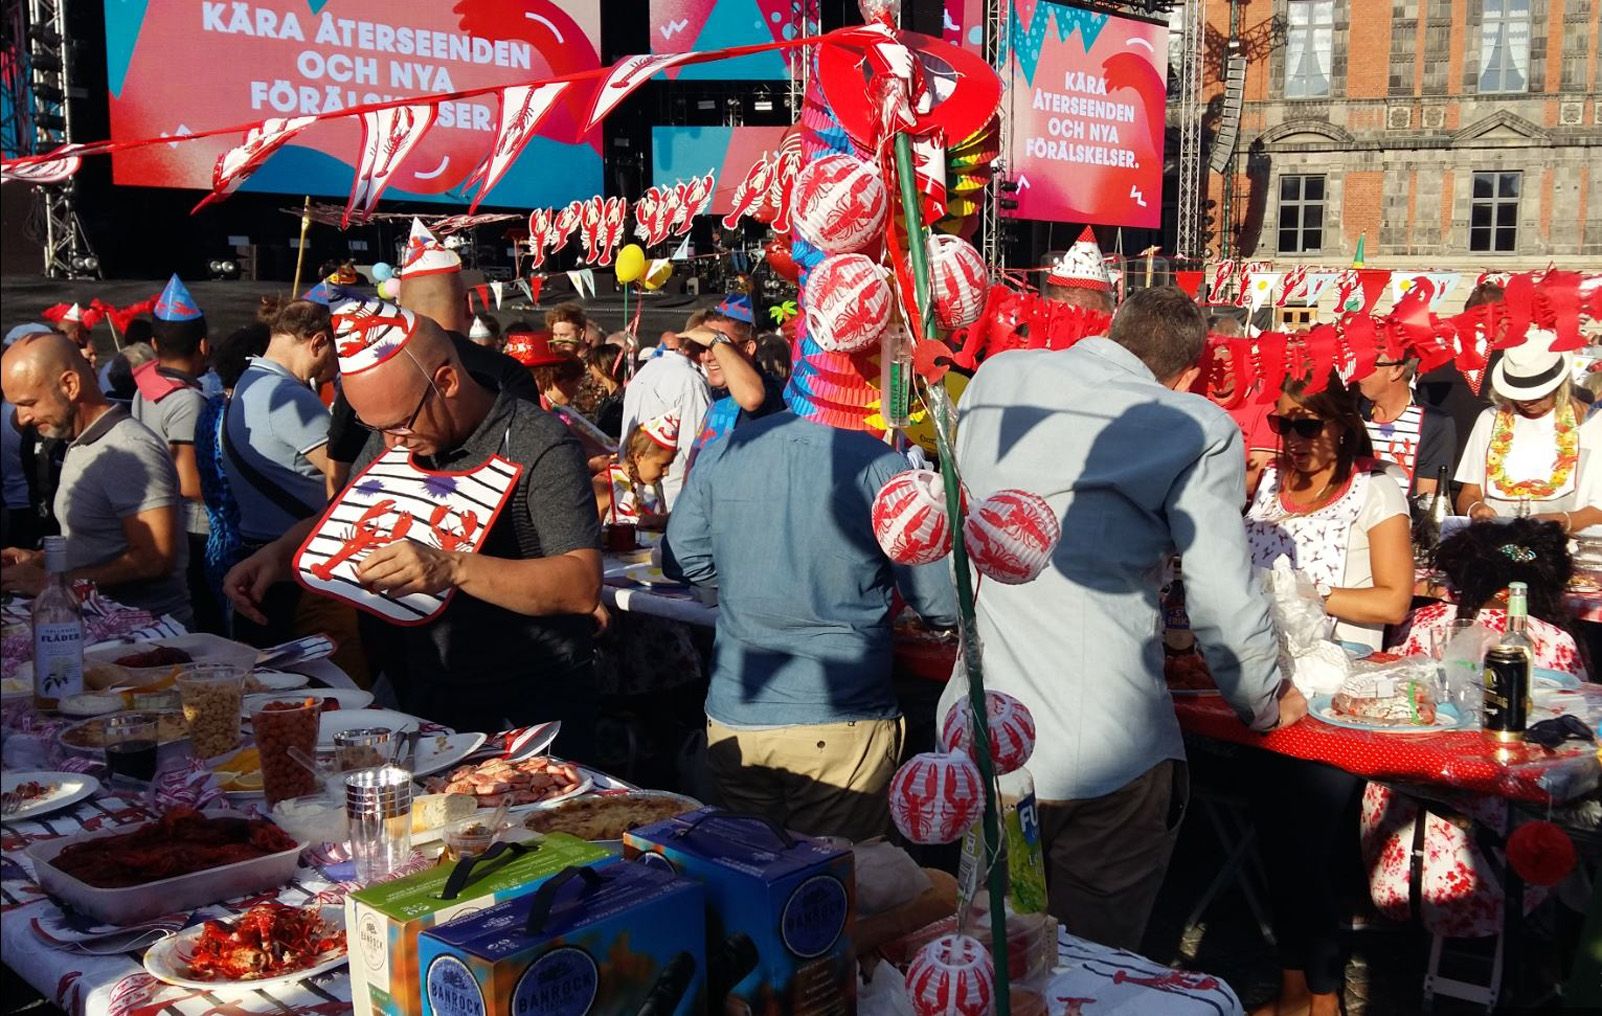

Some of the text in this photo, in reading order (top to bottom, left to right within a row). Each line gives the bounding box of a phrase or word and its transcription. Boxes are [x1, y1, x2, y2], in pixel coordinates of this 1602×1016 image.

[202, 2, 531, 70] KÄRA ÅTERSEENDEN
[297, 50, 455, 94] OCH NYA
[1065, 71, 1107, 96] KÄRA
[1033, 88, 1135, 122] ÅTERSEENDEN
[1048, 117, 1119, 144] OCH NYA
[1026, 137, 1140, 169] FÖRÄLSKELSER.
[432, 982, 481, 1016] BANROCK
